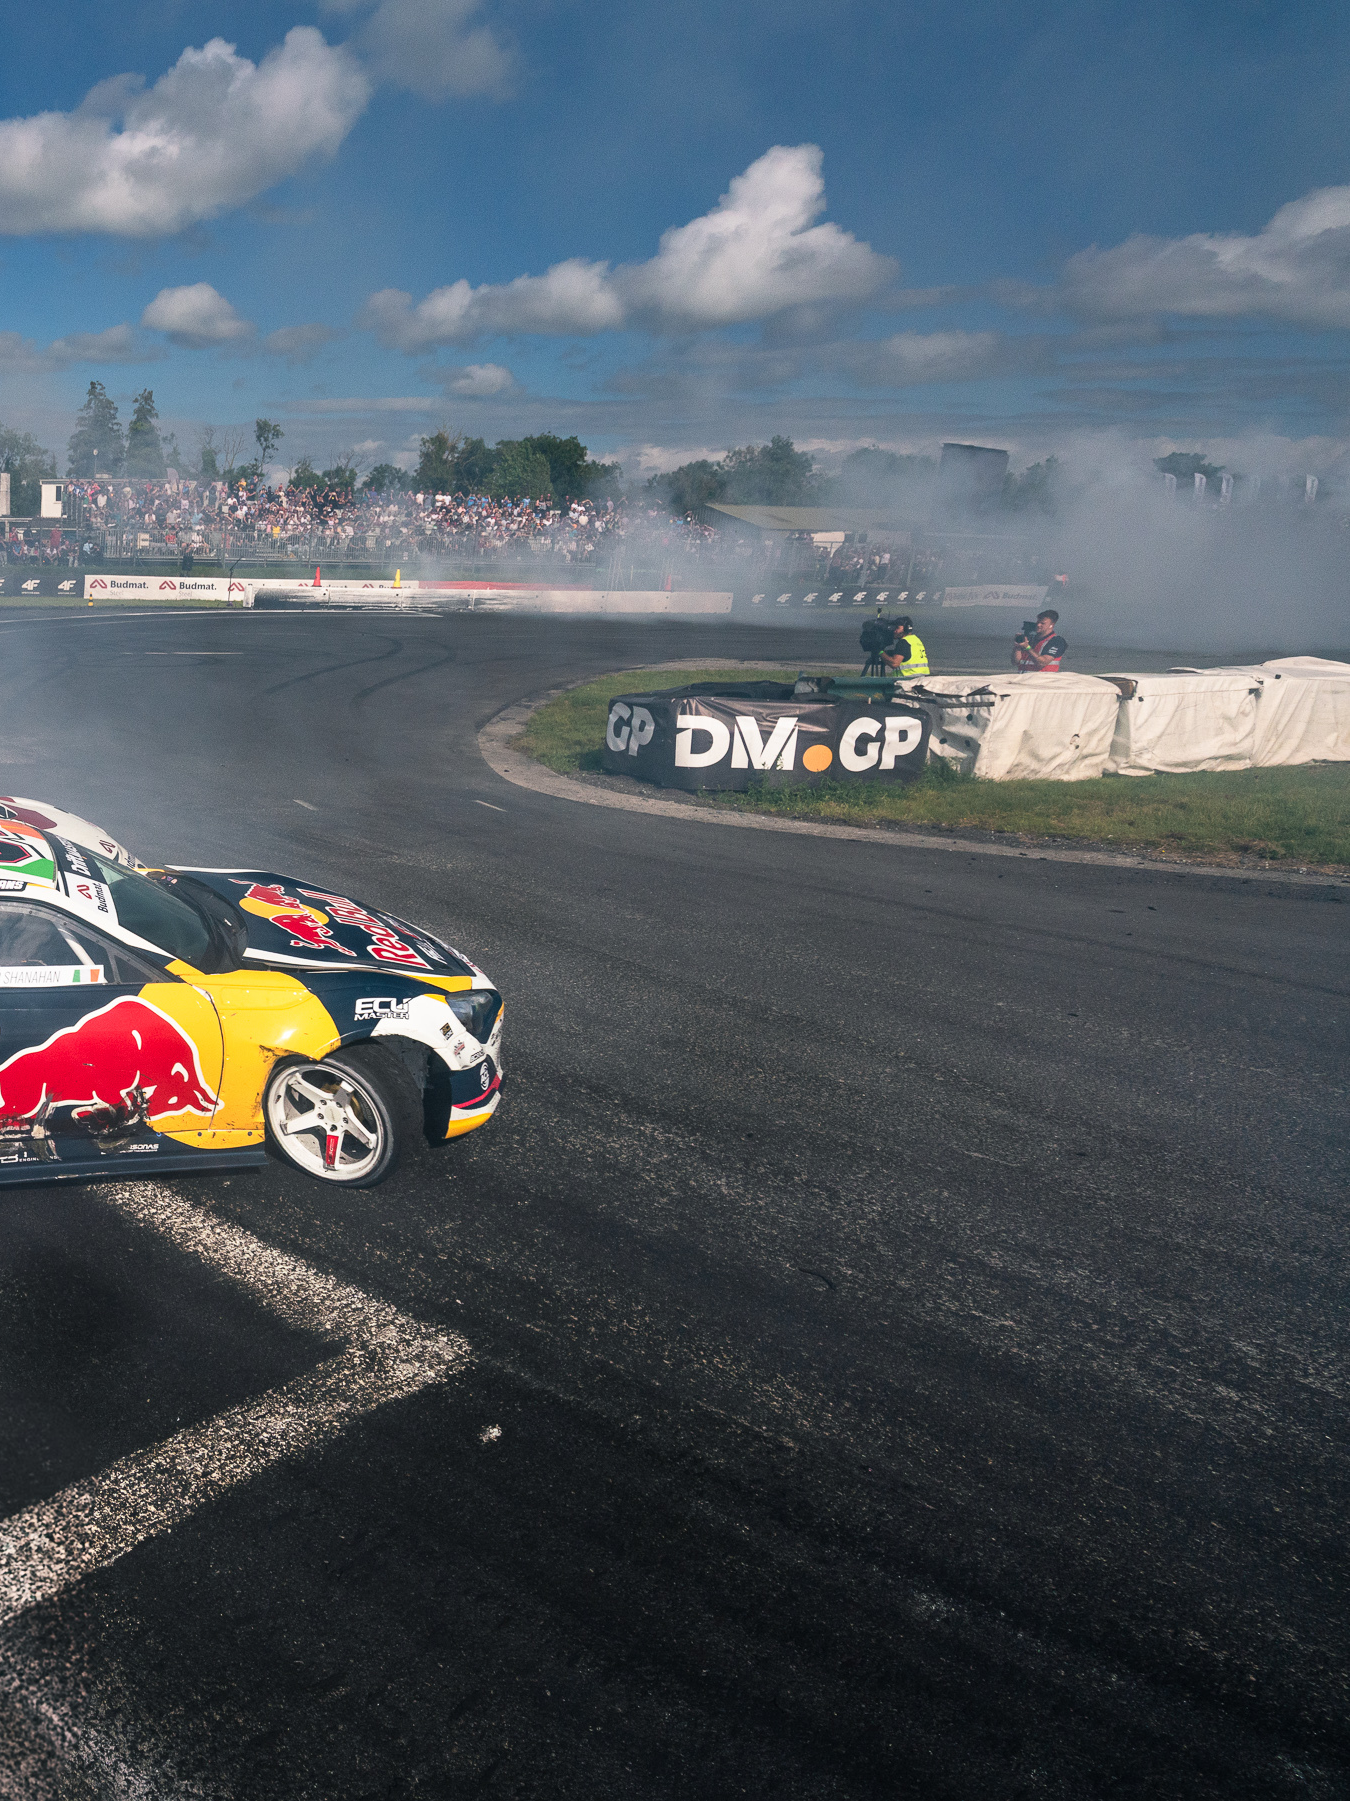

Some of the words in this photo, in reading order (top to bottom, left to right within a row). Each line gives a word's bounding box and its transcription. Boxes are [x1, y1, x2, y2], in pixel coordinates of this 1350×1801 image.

[22, 579, 41, 590] 4F
[58, 580, 77, 591] 4F
[110, 580, 149, 589] Budmat.
[179, 582, 217, 590] Budmat.
[606, 702, 655, 756] GP
[675, 715, 923, 772] DM.GP
[296, 888, 385, 928] Bull
[3, 971, 61, 984] SHANAHAN
[355, 997, 411, 1014] ECU
[354, 1012, 410, 1021] MASTER
